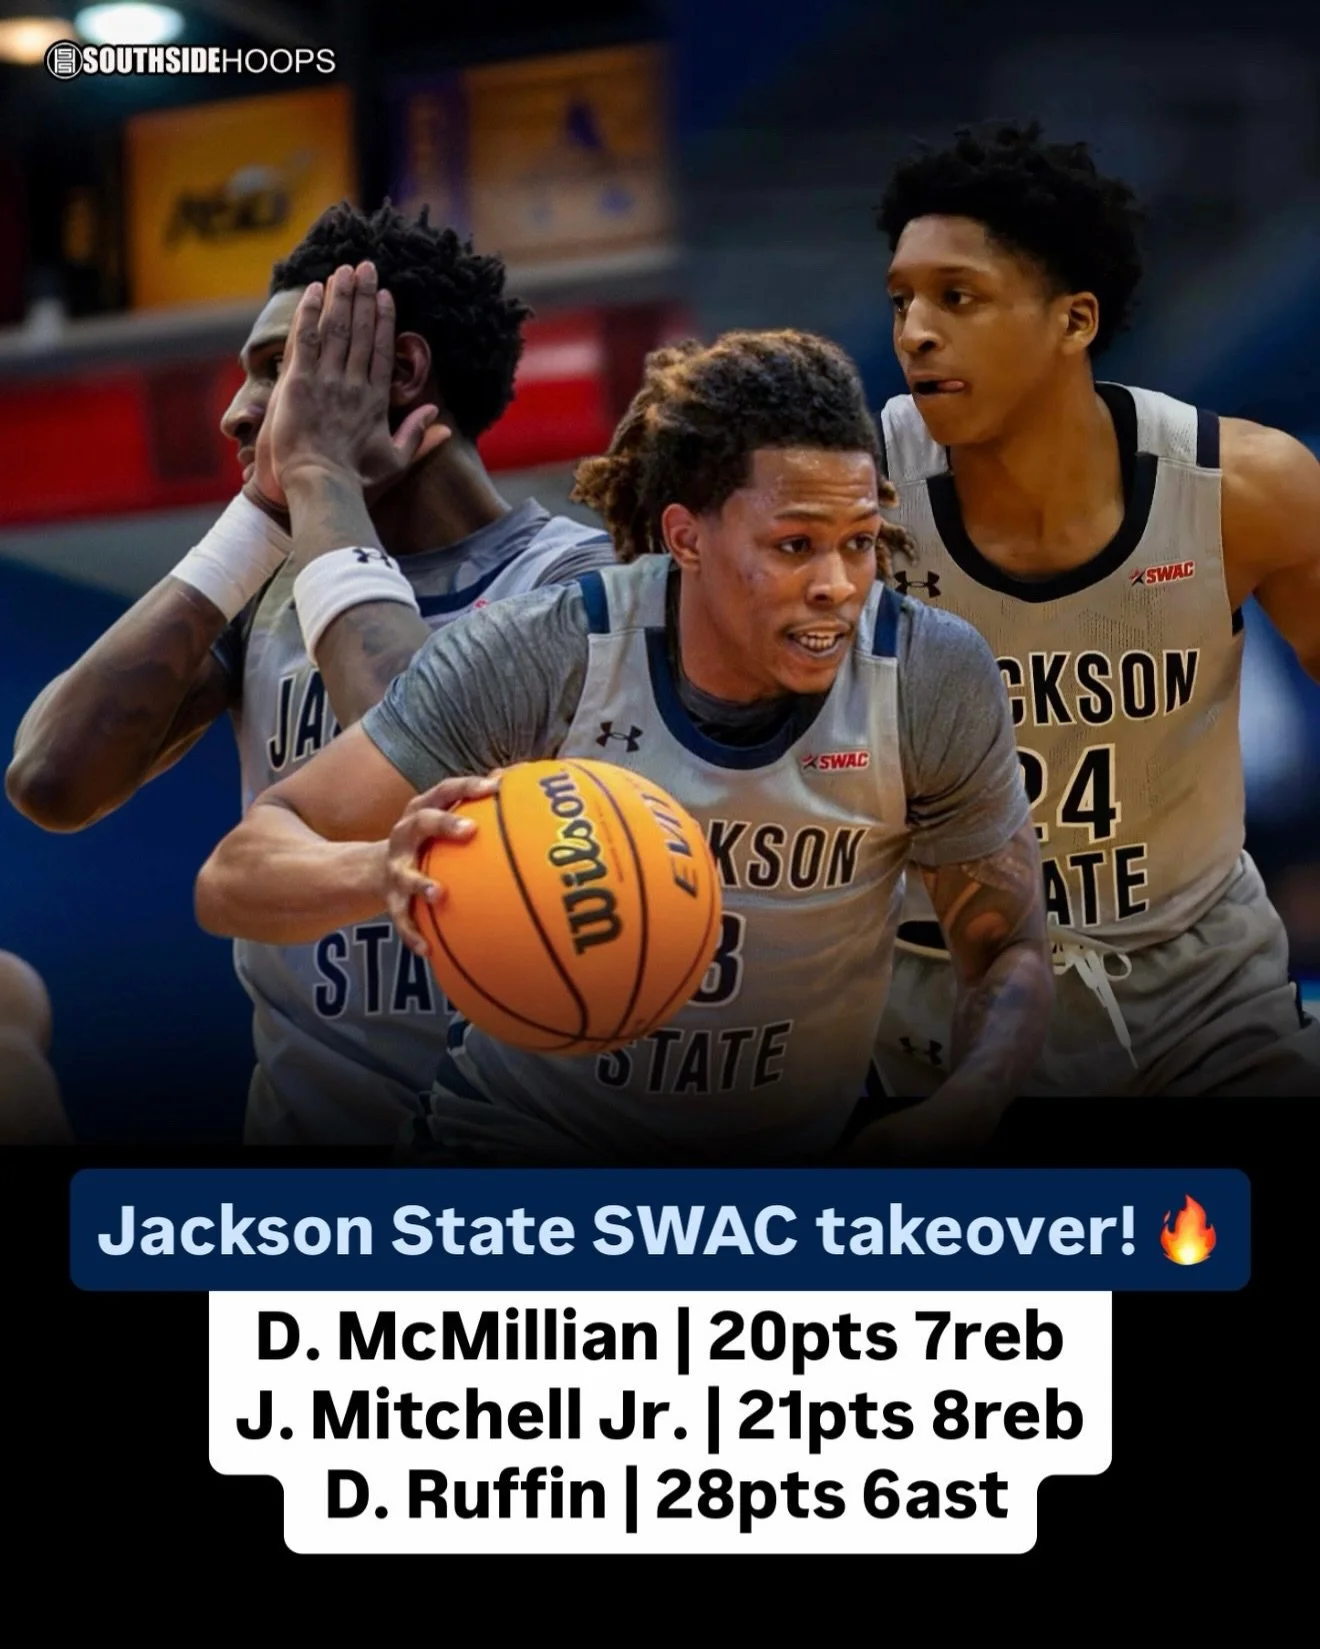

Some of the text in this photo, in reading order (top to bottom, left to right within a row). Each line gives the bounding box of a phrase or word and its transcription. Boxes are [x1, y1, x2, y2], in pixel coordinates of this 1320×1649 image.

[1144, 560, 1197, 586] SWAC
[996, 647, 1200, 727] CKSON
[818, 750, 870, 771] SWAC
[537, 772, 626, 956] Wilson
[706, 818, 873, 890] KSON
[1042, 842, 1150, 928] ATE
[313, 921, 456, 1020] STA
